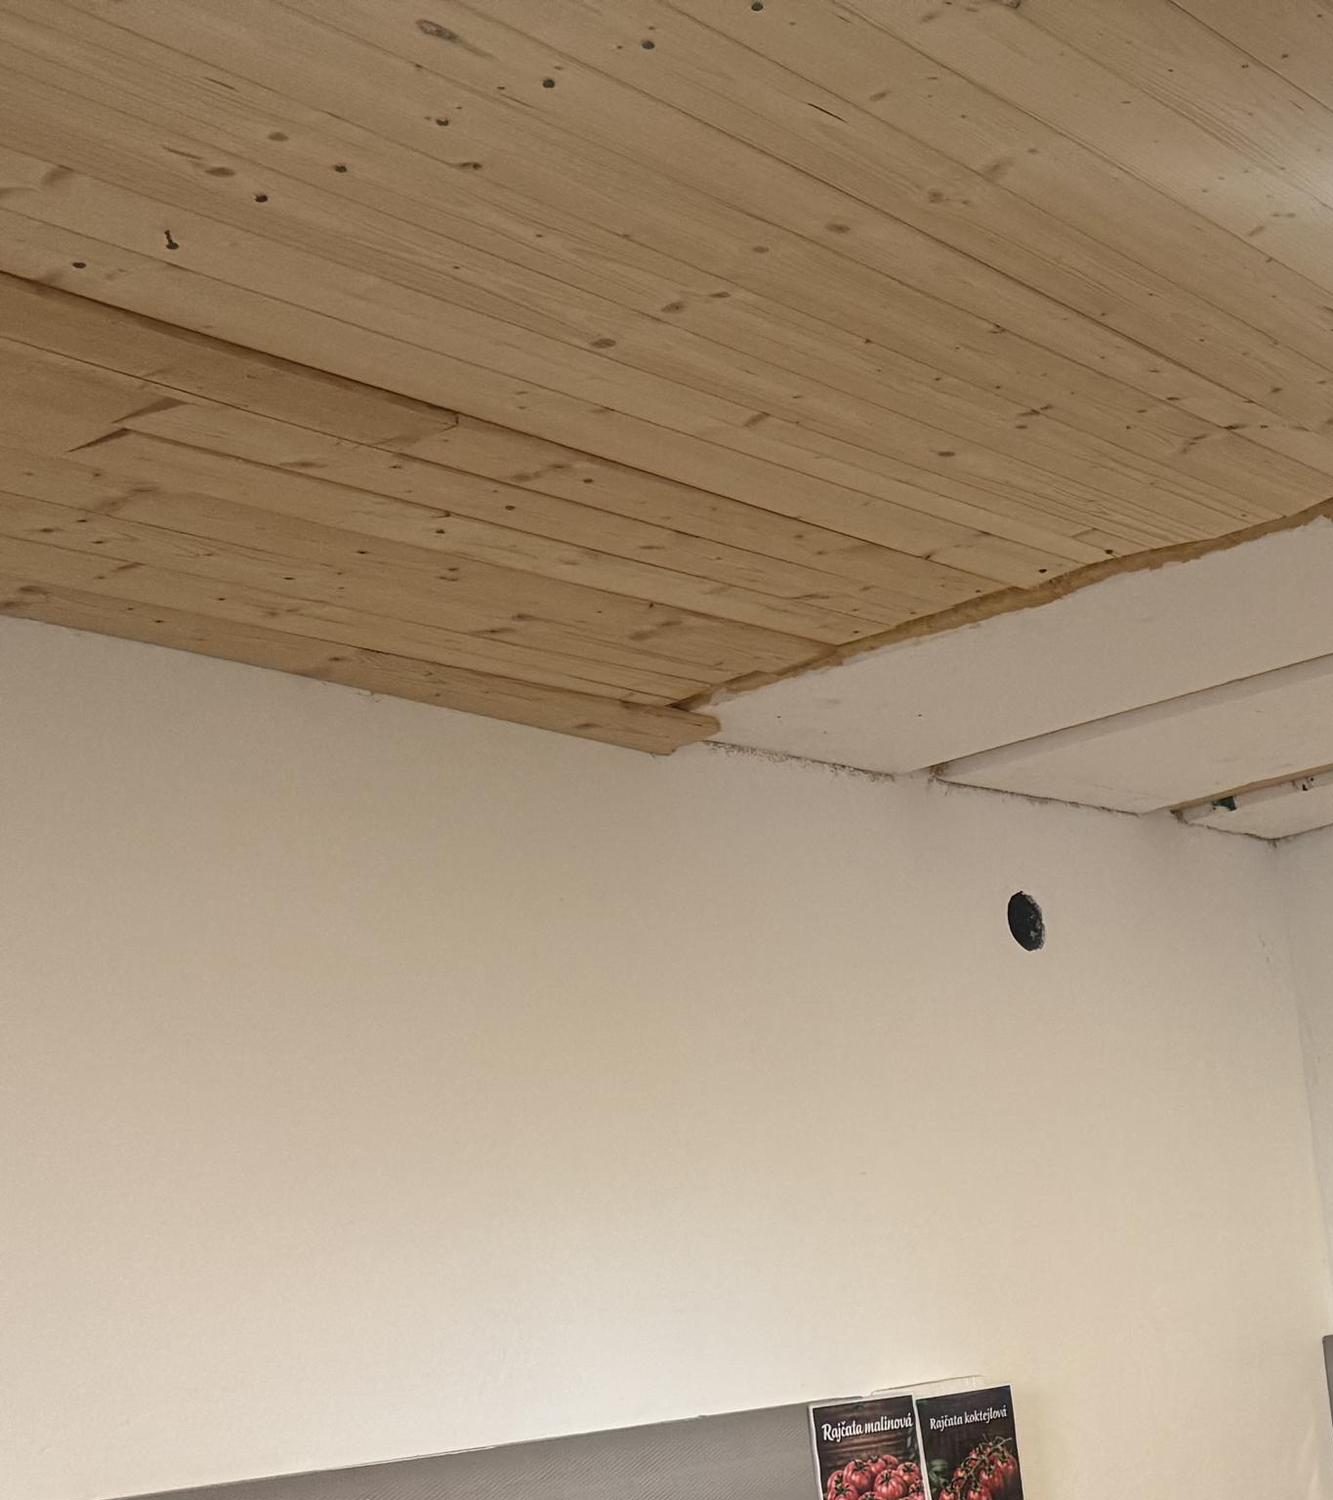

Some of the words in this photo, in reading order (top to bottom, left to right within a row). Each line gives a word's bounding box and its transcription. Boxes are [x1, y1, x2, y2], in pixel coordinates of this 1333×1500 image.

[821, 1420, 863, 1443] Rajčata
[865, 1412, 913, 1434] malinová
[929, 1416, 963, 1432] Rajčata
[964, 1404, 1008, 1426] koktejlová
